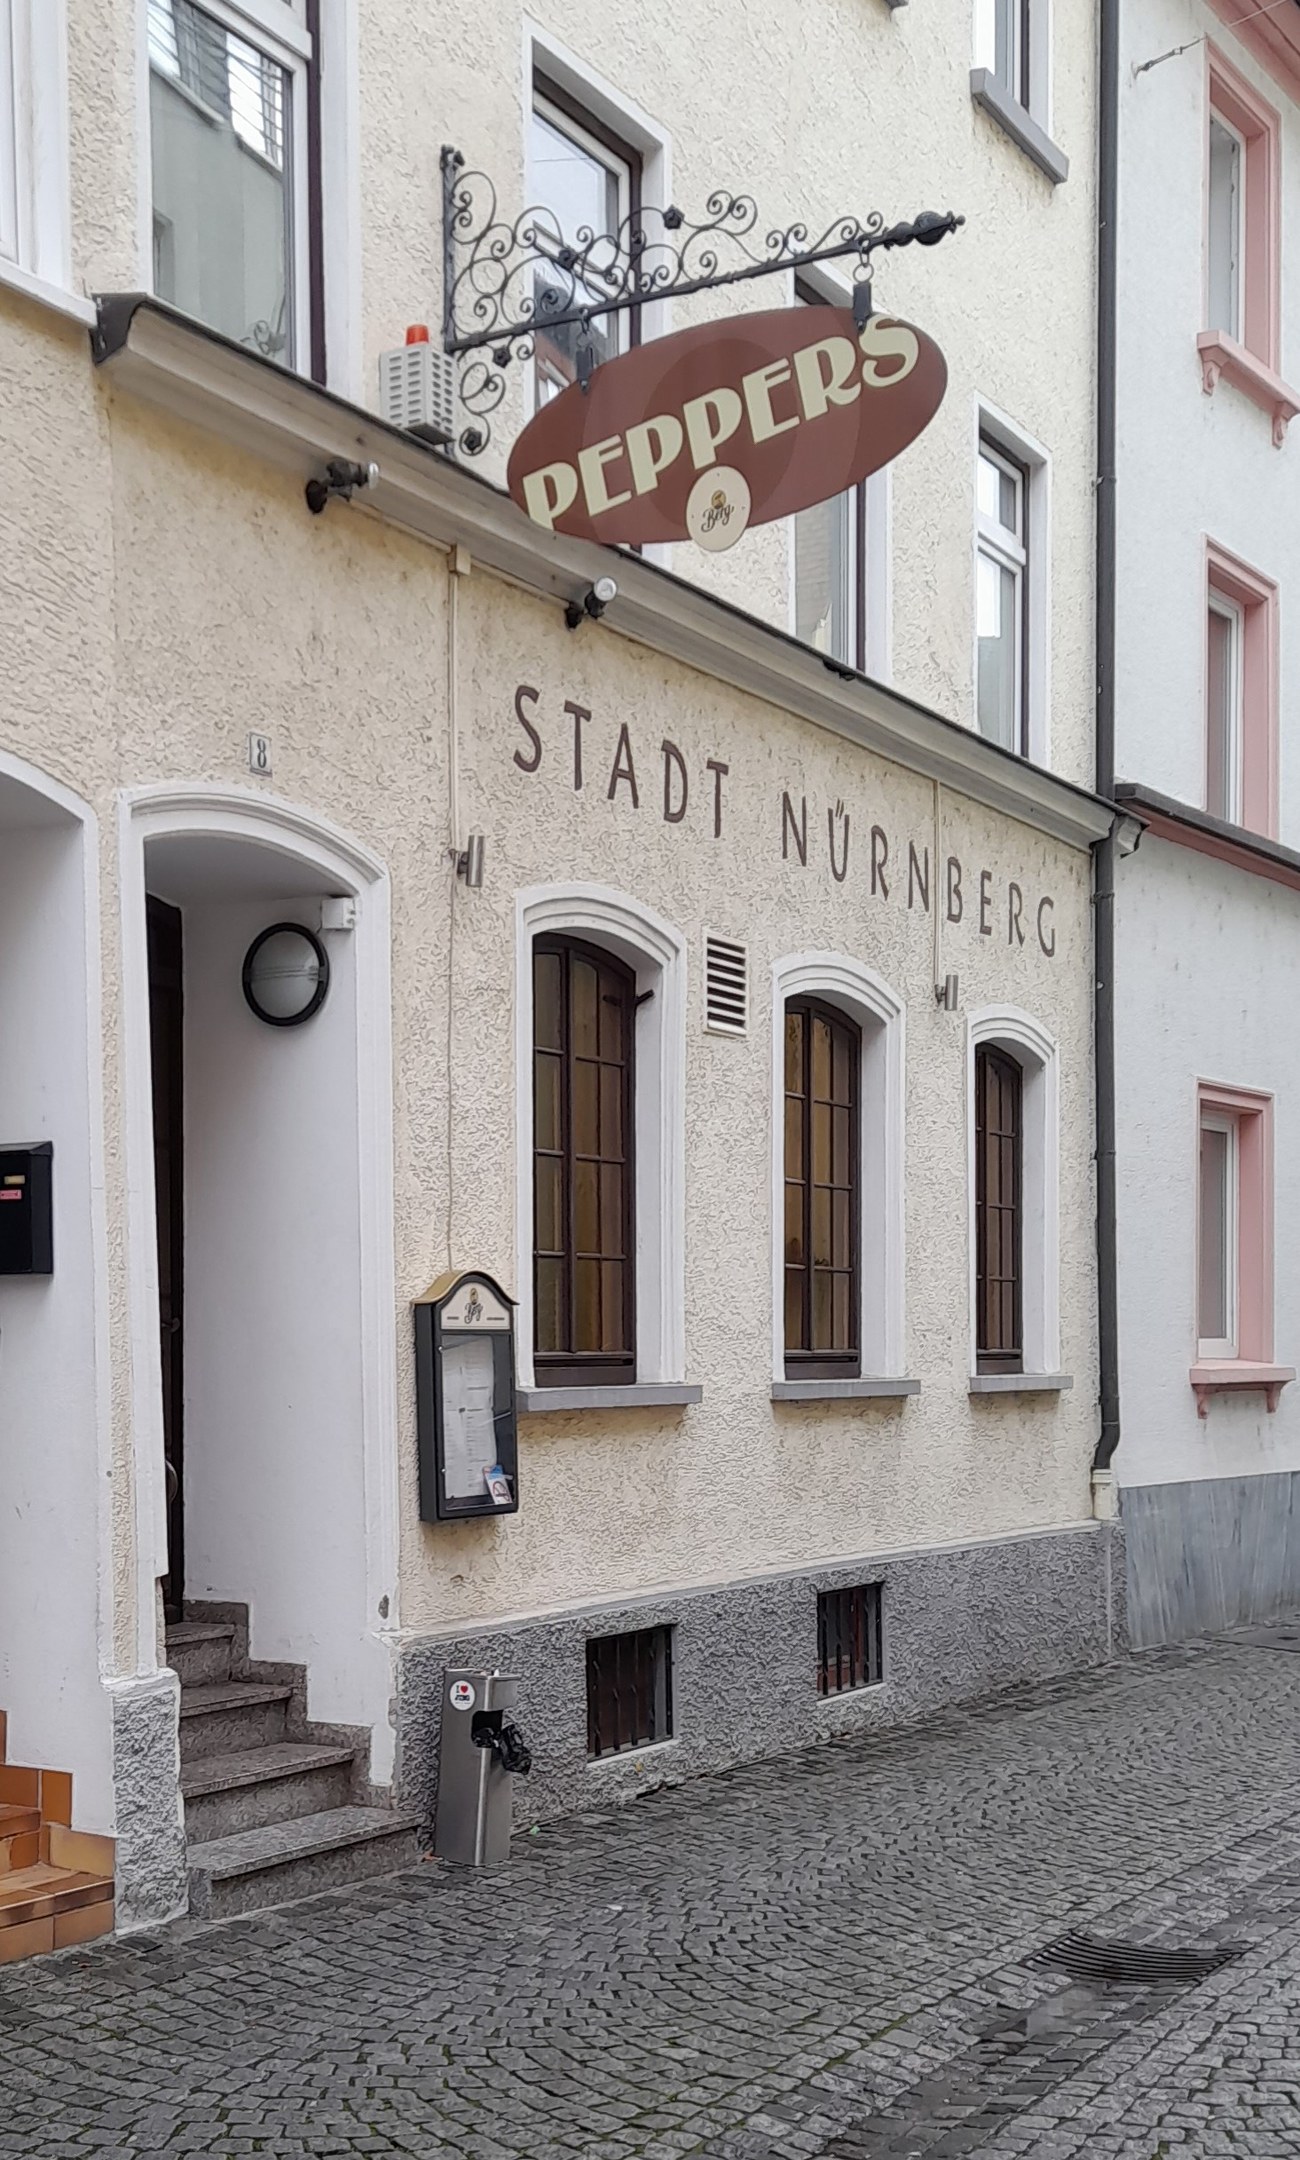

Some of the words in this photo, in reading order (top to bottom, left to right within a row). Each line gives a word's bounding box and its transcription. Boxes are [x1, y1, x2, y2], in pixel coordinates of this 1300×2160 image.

[523, 313, 919, 531] PEPPERS
[256, 738, 267, 769] 8
[512, 685, 729, 838] STADT
[782, 792, 1056, 958] NÜRNBERG
